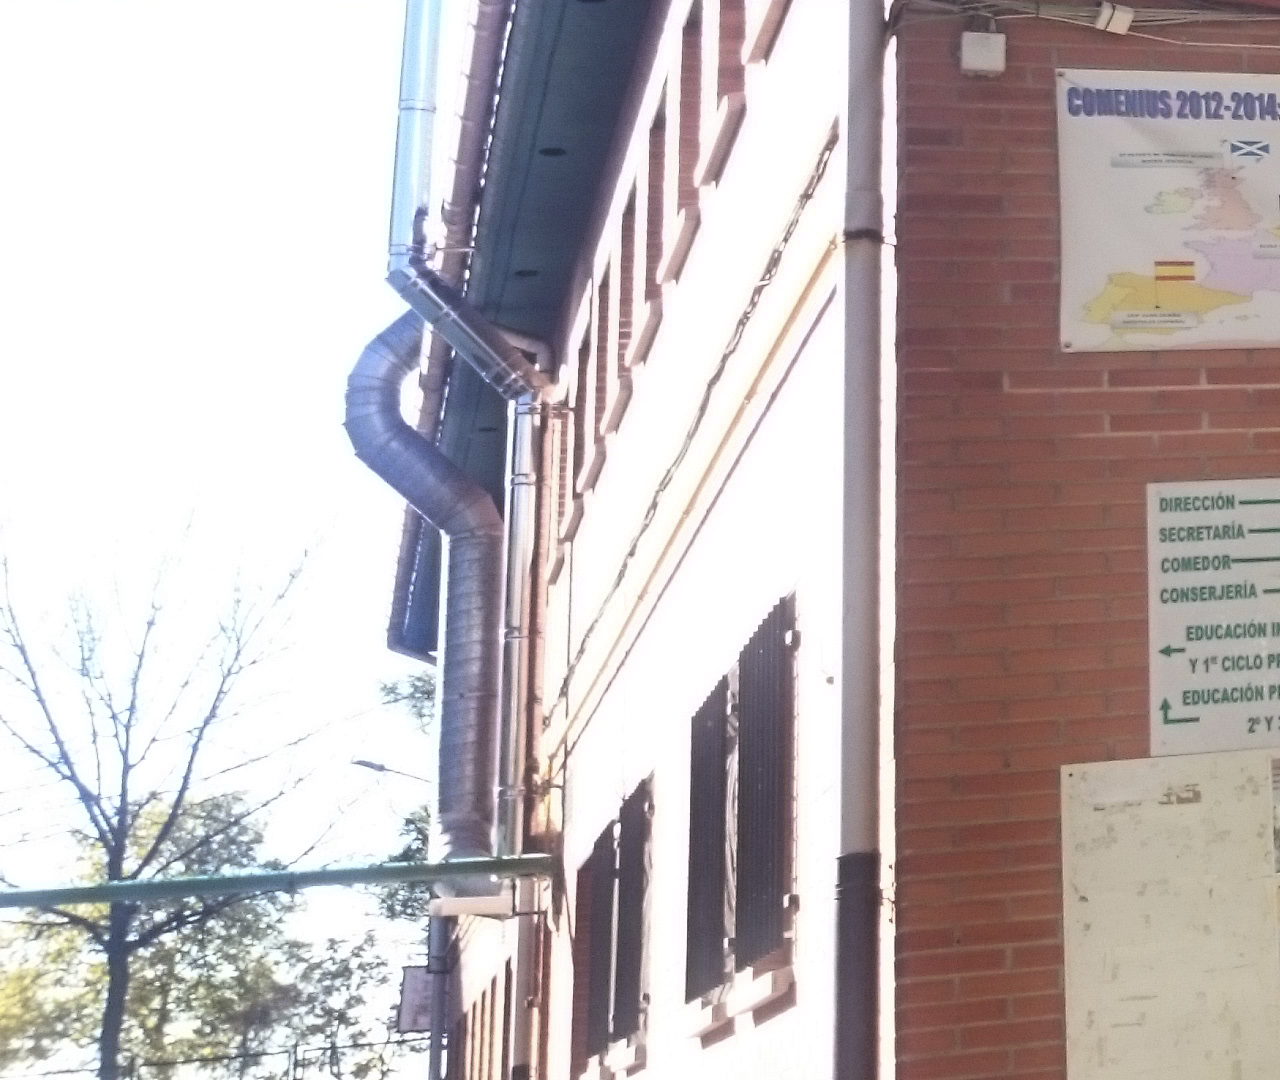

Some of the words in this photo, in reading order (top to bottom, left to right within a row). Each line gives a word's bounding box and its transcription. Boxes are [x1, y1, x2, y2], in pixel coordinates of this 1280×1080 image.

[1067, 86, 1172, 118] COMENIUS
[1159, 492, 1235, 512] DIRECCIÓN
[1159, 522, 1245, 542] SECRETARÍA
[1161, 555, 1231, 573] COMEDOR
[1160, 580, 1257, 603] CONSERJERÍA
[1186, 620, 1267, 641] EDUCACIÓN
[1189, 658, 1198, 674] Y
[1222, 655, 1263, 671] CICLO
[1182, 683, 1264, 705] EDUCACIÓN
[1264, 717, 1274, 731] Y
